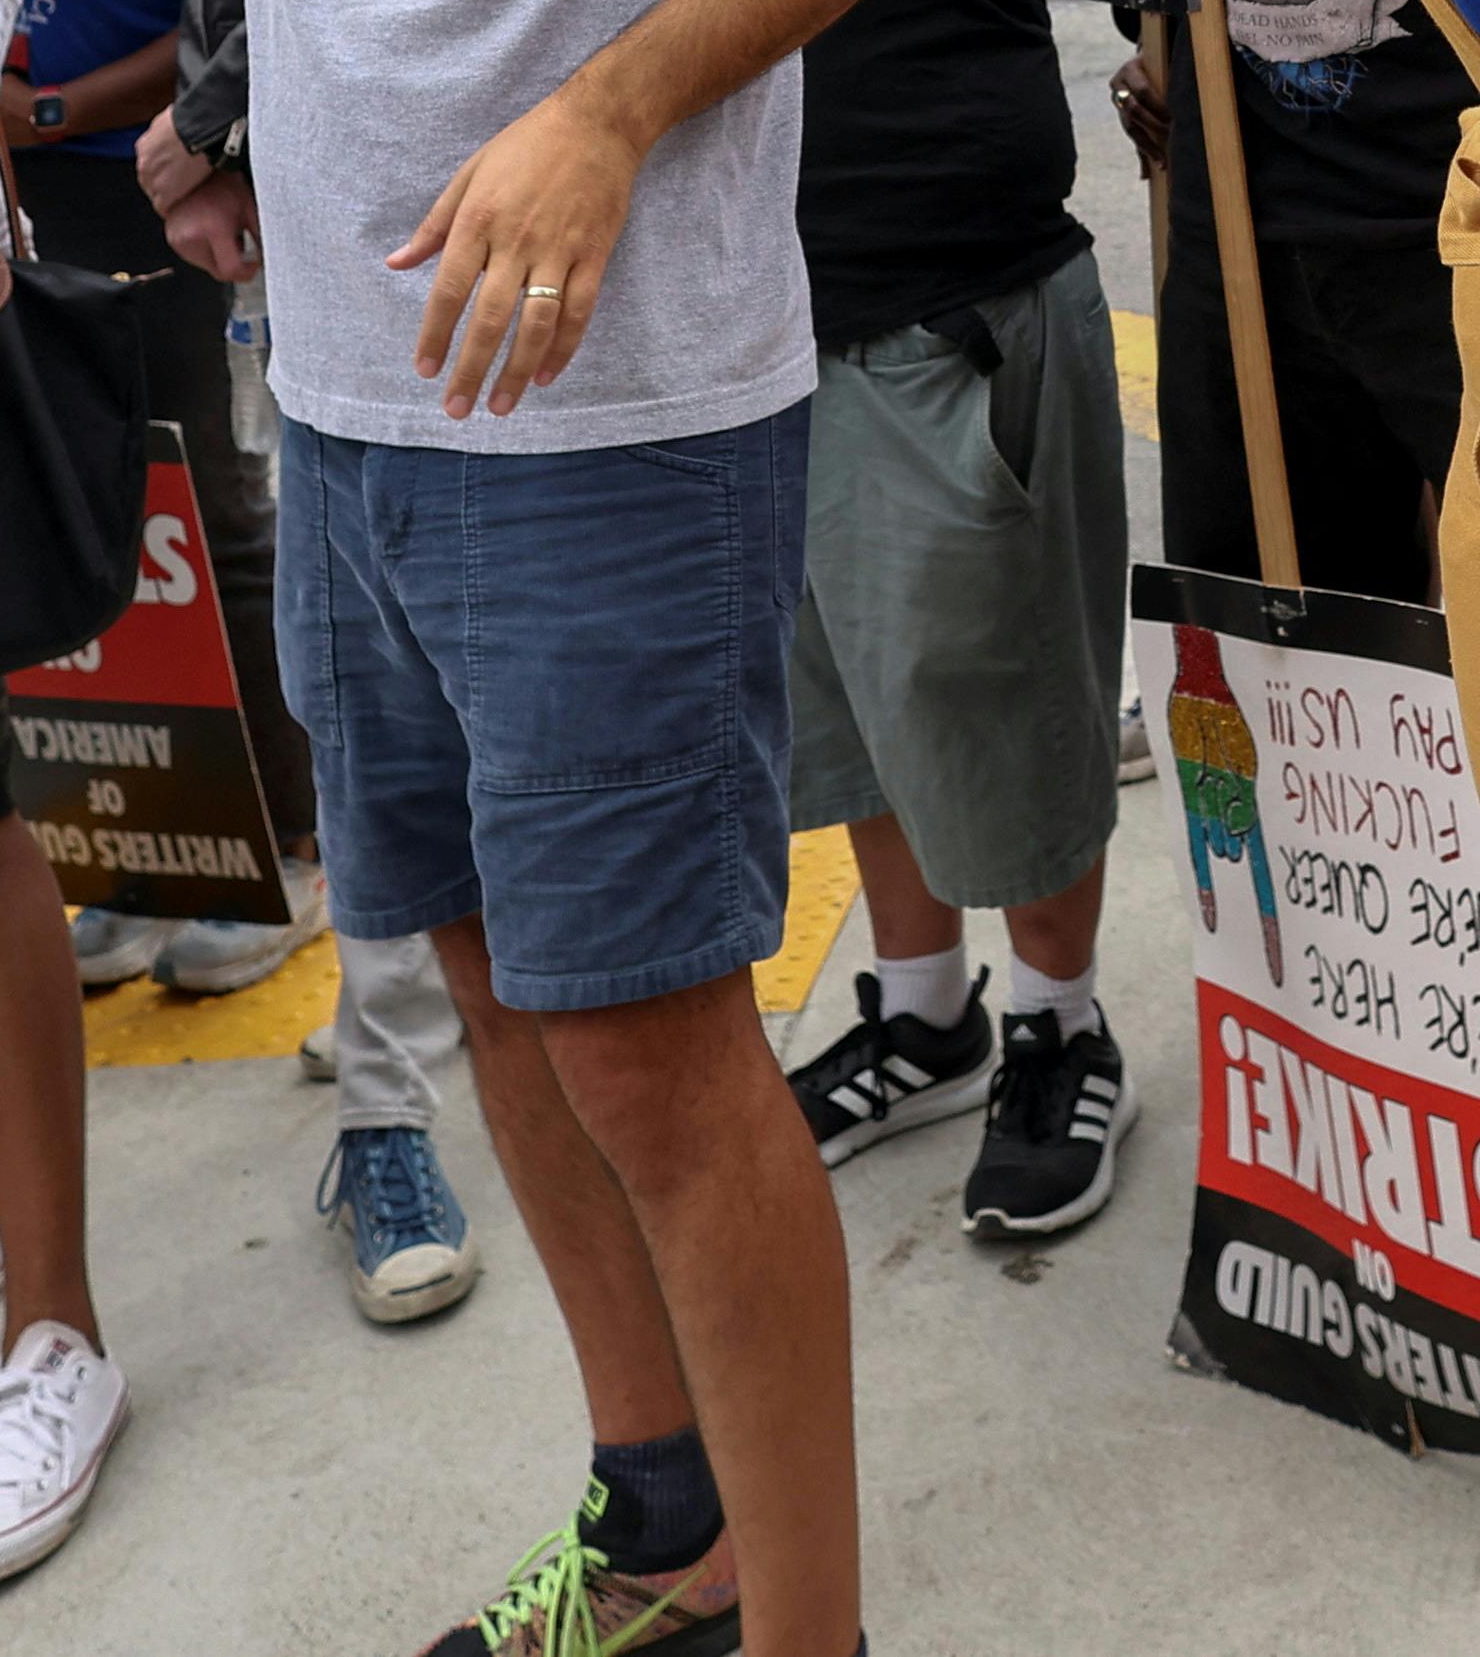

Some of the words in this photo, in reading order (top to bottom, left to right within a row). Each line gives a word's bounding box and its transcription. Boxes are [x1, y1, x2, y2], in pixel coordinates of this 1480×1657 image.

[1266, 32, 1293, 48] NO
[10, 716, 173, 770] AMERICA
[1265, 679, 1360, 750] US!!!
[1387, 693, 1463, 776] PAY
[86, 778, 127, 817] OF
[1282, 761, 1462, 864] FUCKING
[97, 828, 263, 883] WRITERS
[1279, 845, 1390, 935] QUEER
[1304, 943, 1401, 1041] HERE
[1214, 1237, 1355, 1362] GUILD
[1353, 1237, 1396, 1302] ON
